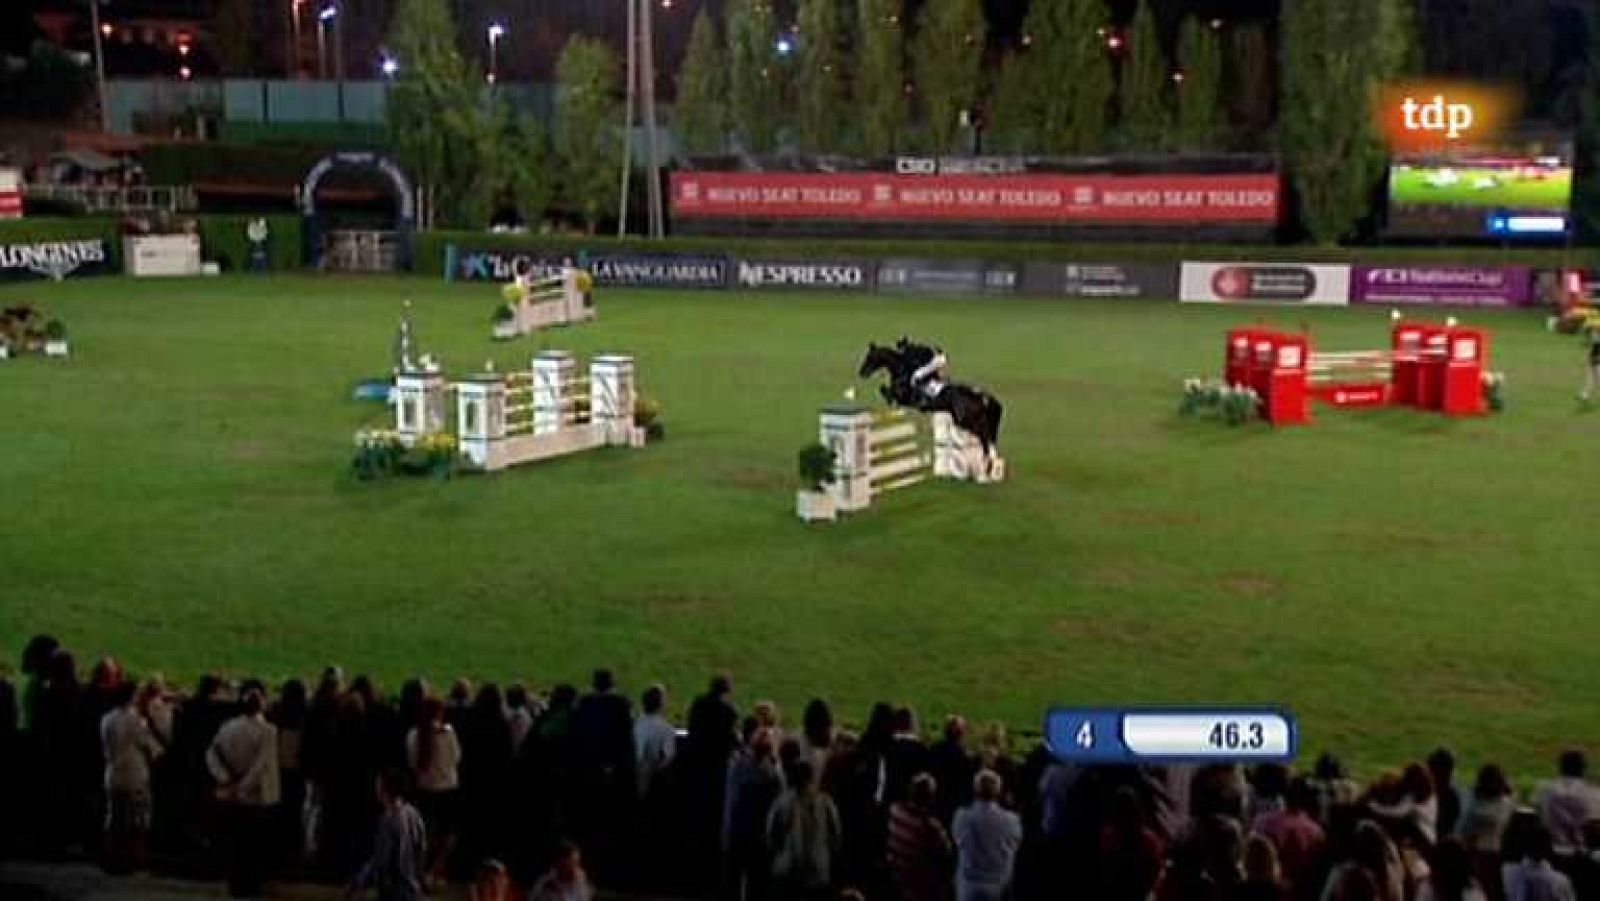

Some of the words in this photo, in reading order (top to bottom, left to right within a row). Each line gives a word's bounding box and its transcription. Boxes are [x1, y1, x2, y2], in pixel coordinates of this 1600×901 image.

[763, 186, 798, 202] SEAT
[801, 187, 861, 203] TOLEDO
[957, 188, 996, 205] SEAT
[999, 189, 1061, 206] TOLEDO
[1164, 190, 1203, 207] SEAT
[1207, 190, 1274, 207] TOLEDO
[0, 239, 104, 267] LONGINES
[739, 262, 862, 286] NESPRESSO
